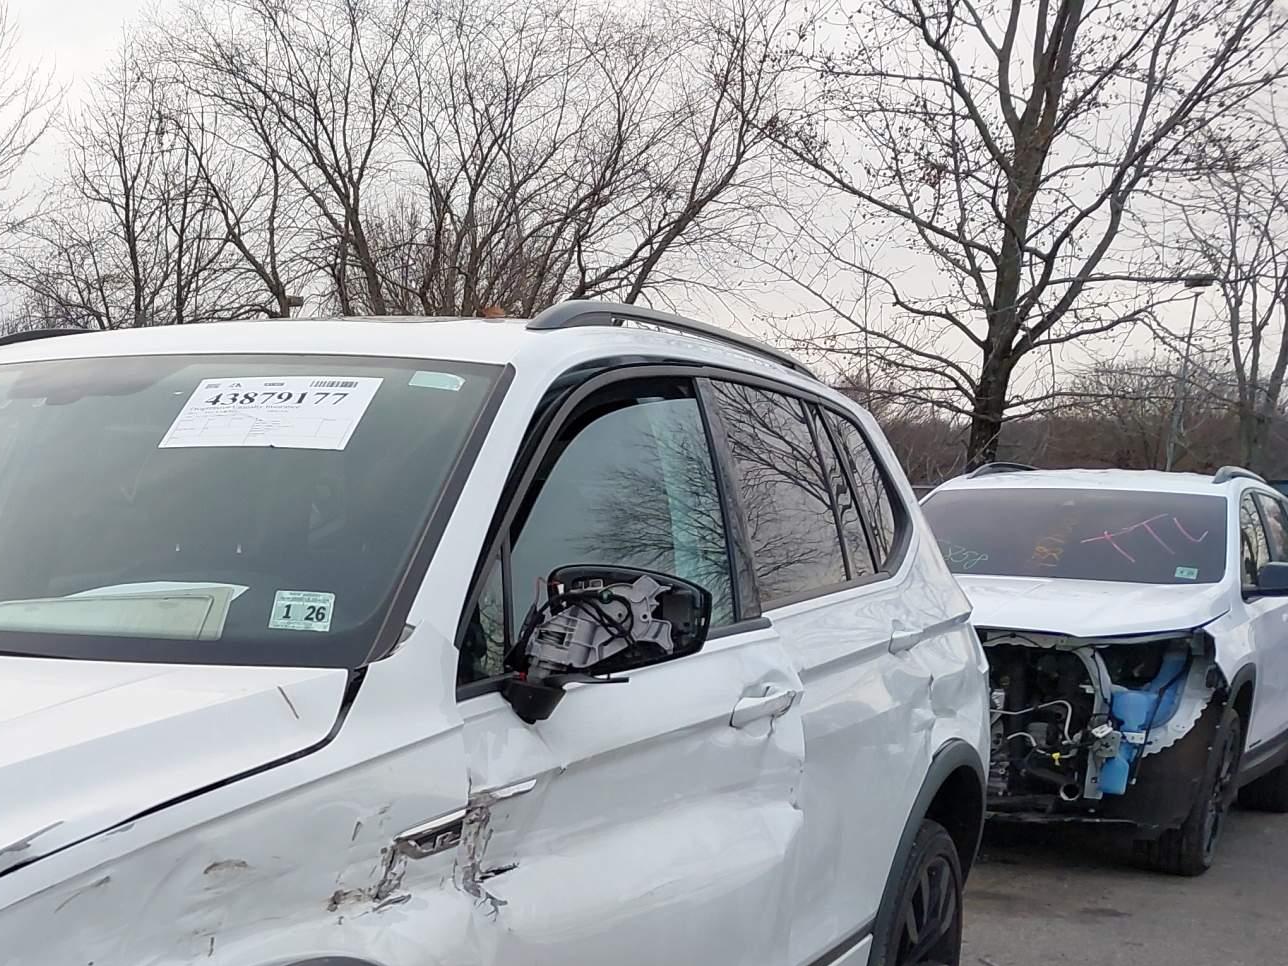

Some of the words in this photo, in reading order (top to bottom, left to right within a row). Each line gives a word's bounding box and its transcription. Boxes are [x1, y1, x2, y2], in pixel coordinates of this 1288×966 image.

[205, 391, 349, 405] 43879177
[282, 604, 292, 619] 1
[304, 605, 327, 622] 26
